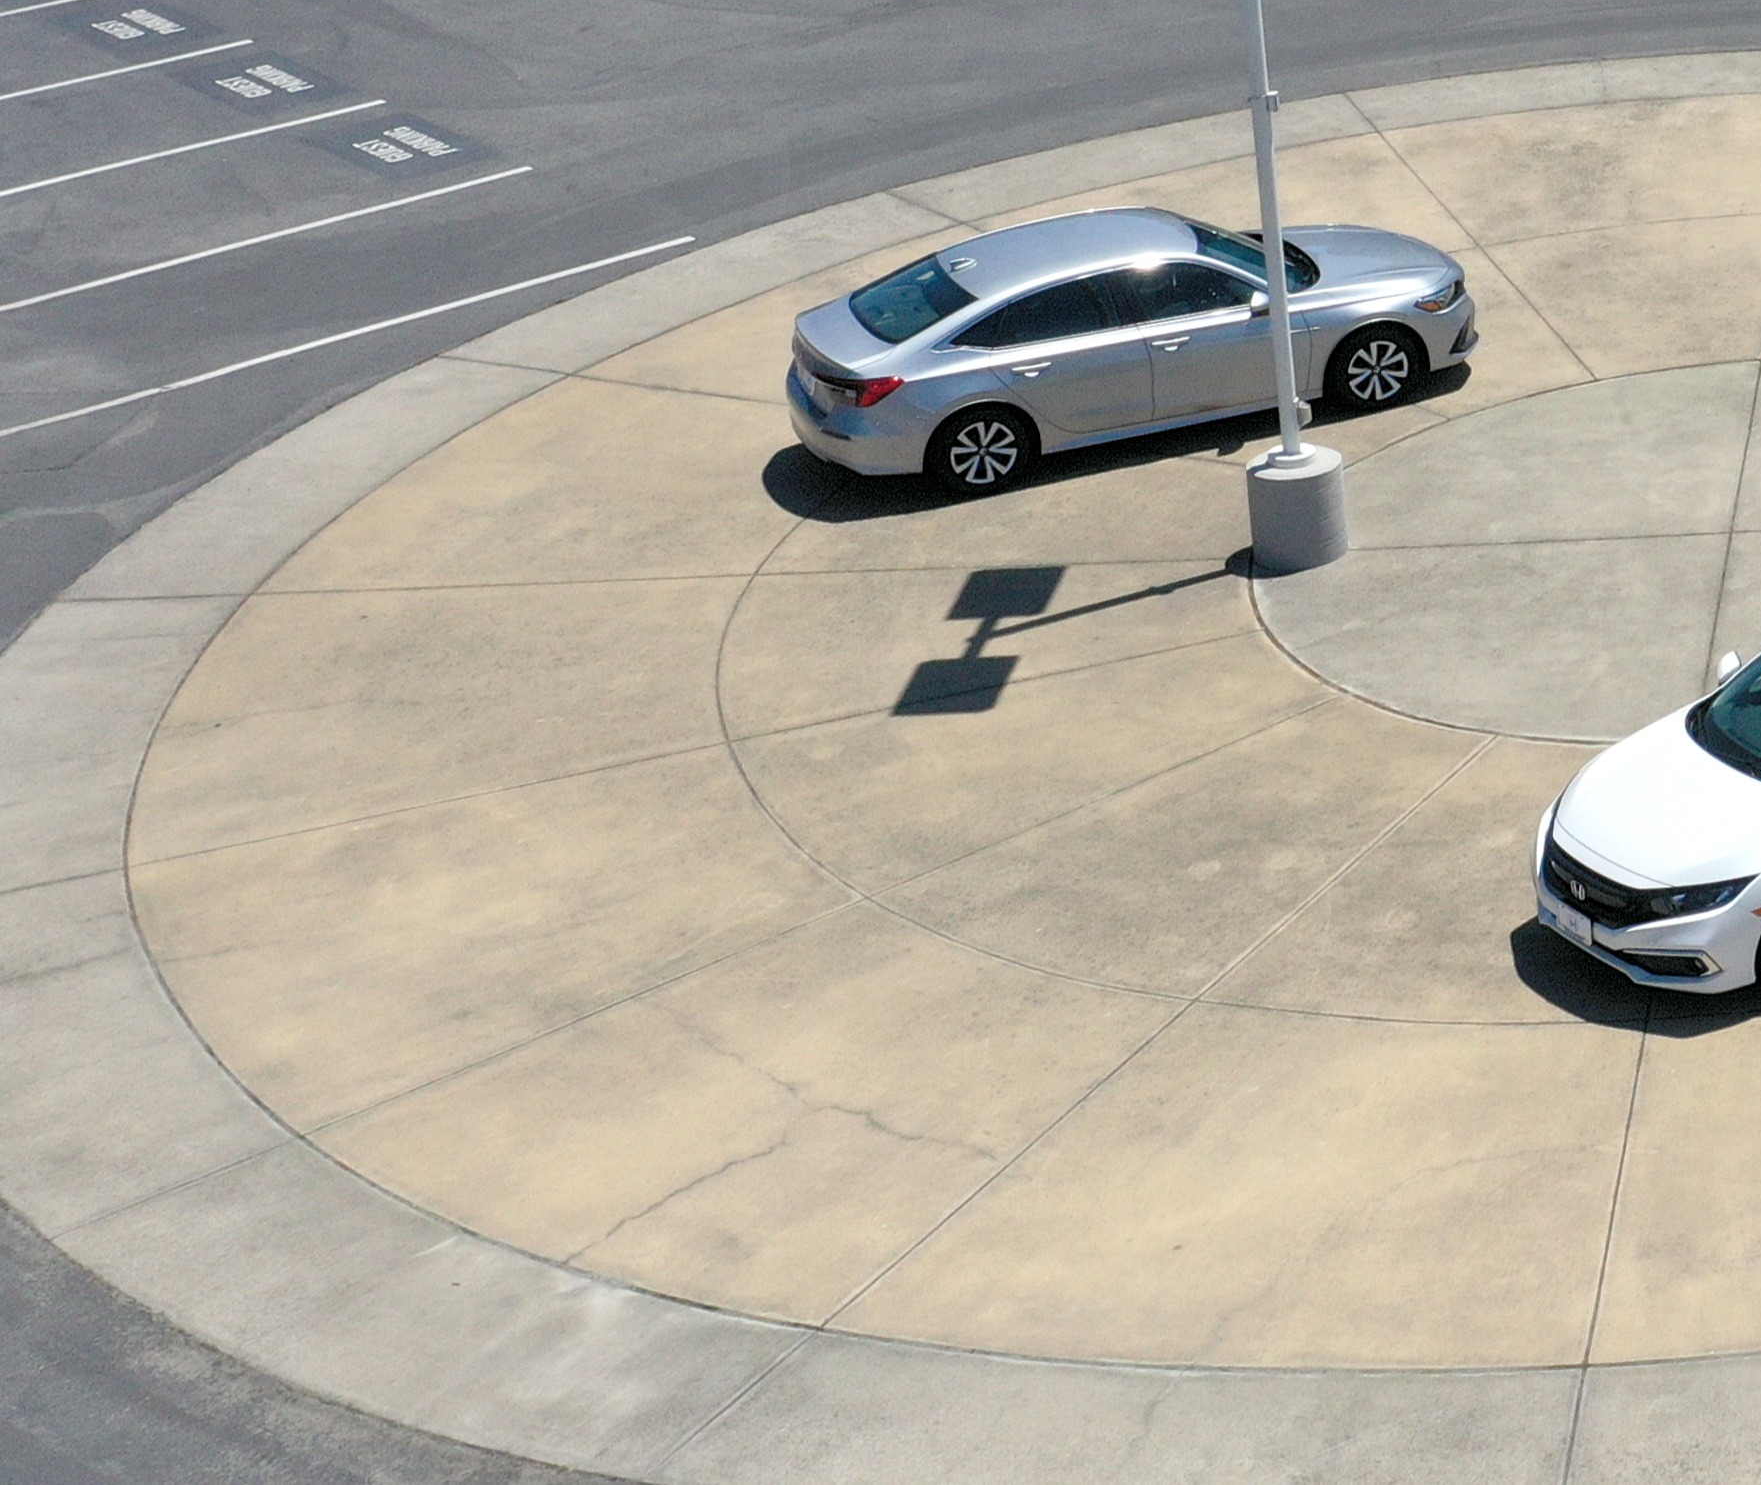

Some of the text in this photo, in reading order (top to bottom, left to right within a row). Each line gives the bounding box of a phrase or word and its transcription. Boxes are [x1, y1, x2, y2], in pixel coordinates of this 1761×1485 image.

[215, 76, 273, 98] GUEST
[245, 64, 315, 93] PARKING
[352, 139, 414, 163] GUEST
[383, 126, 458, 157] PARKING
